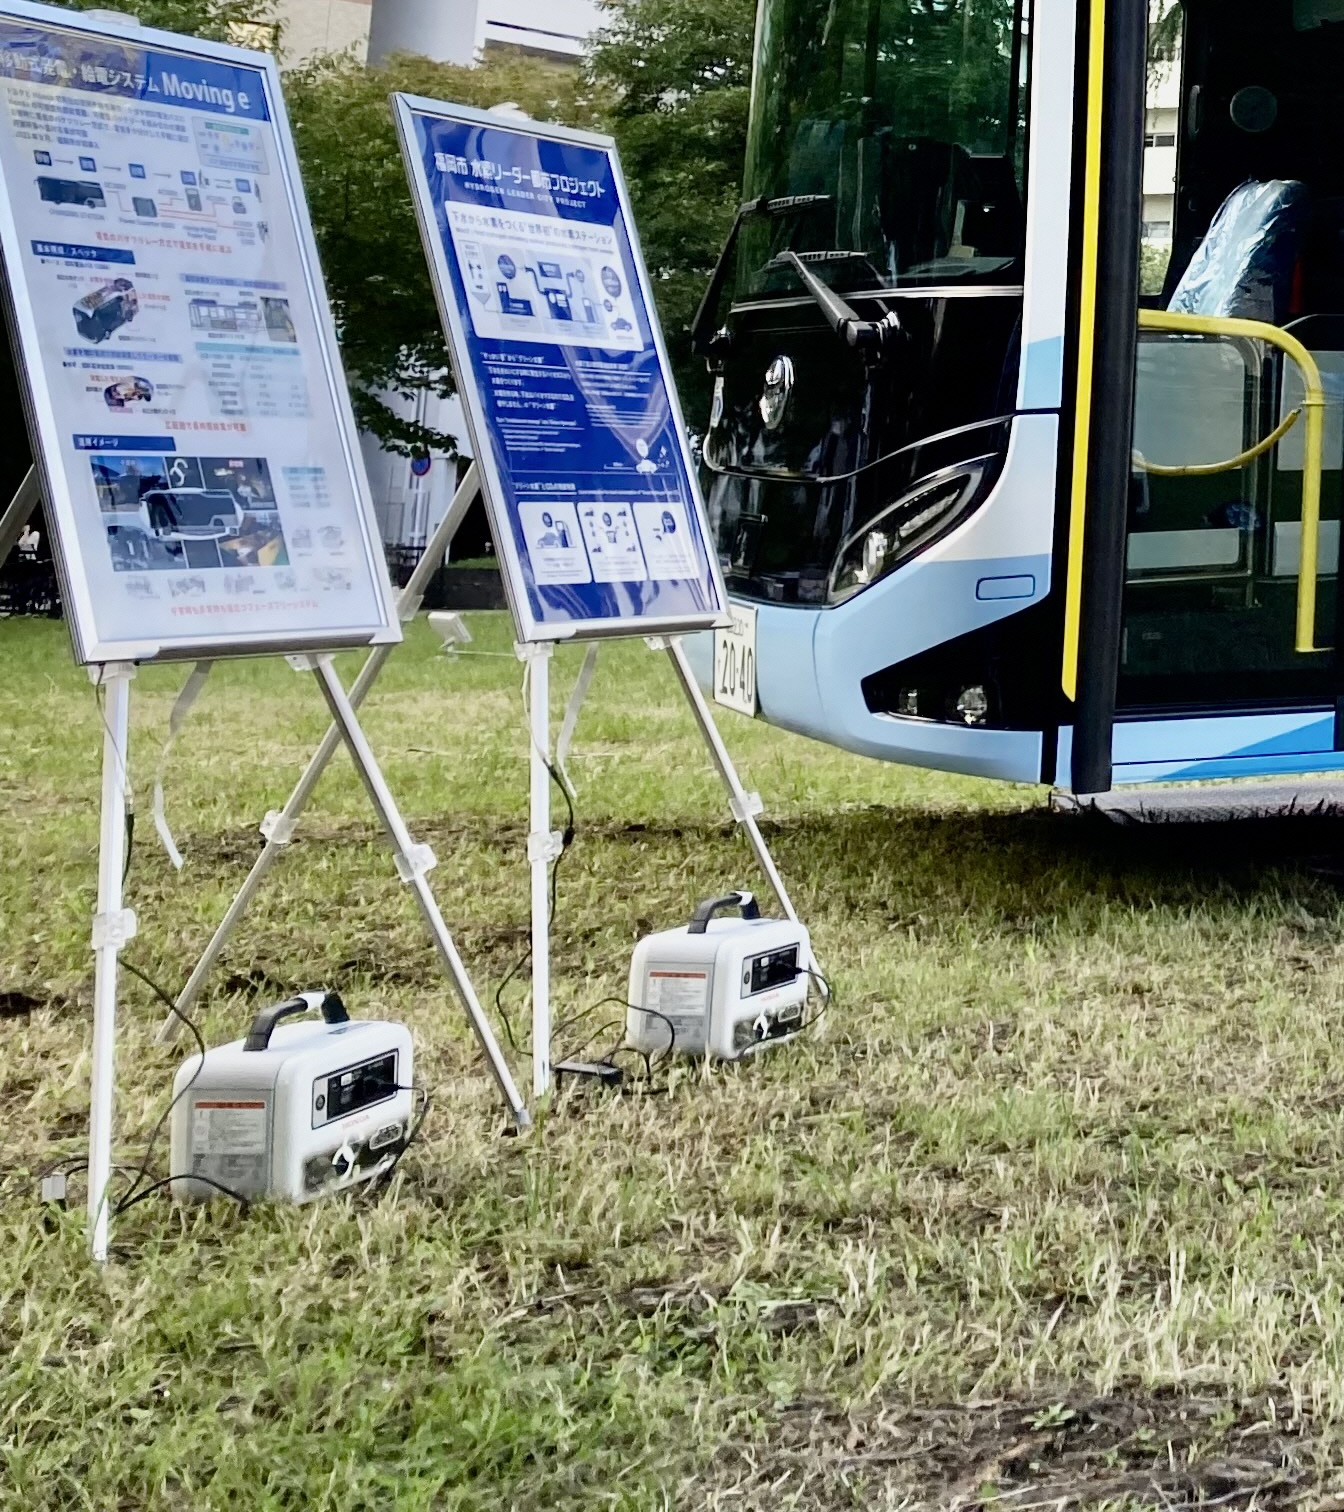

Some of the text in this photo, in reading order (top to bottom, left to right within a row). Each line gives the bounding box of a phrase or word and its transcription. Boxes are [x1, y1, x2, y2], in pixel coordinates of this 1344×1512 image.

[162, 72, 235, 113] Moving
[237, 90, 251, 110] e
[434, 152, 468, 176] 福岡市
